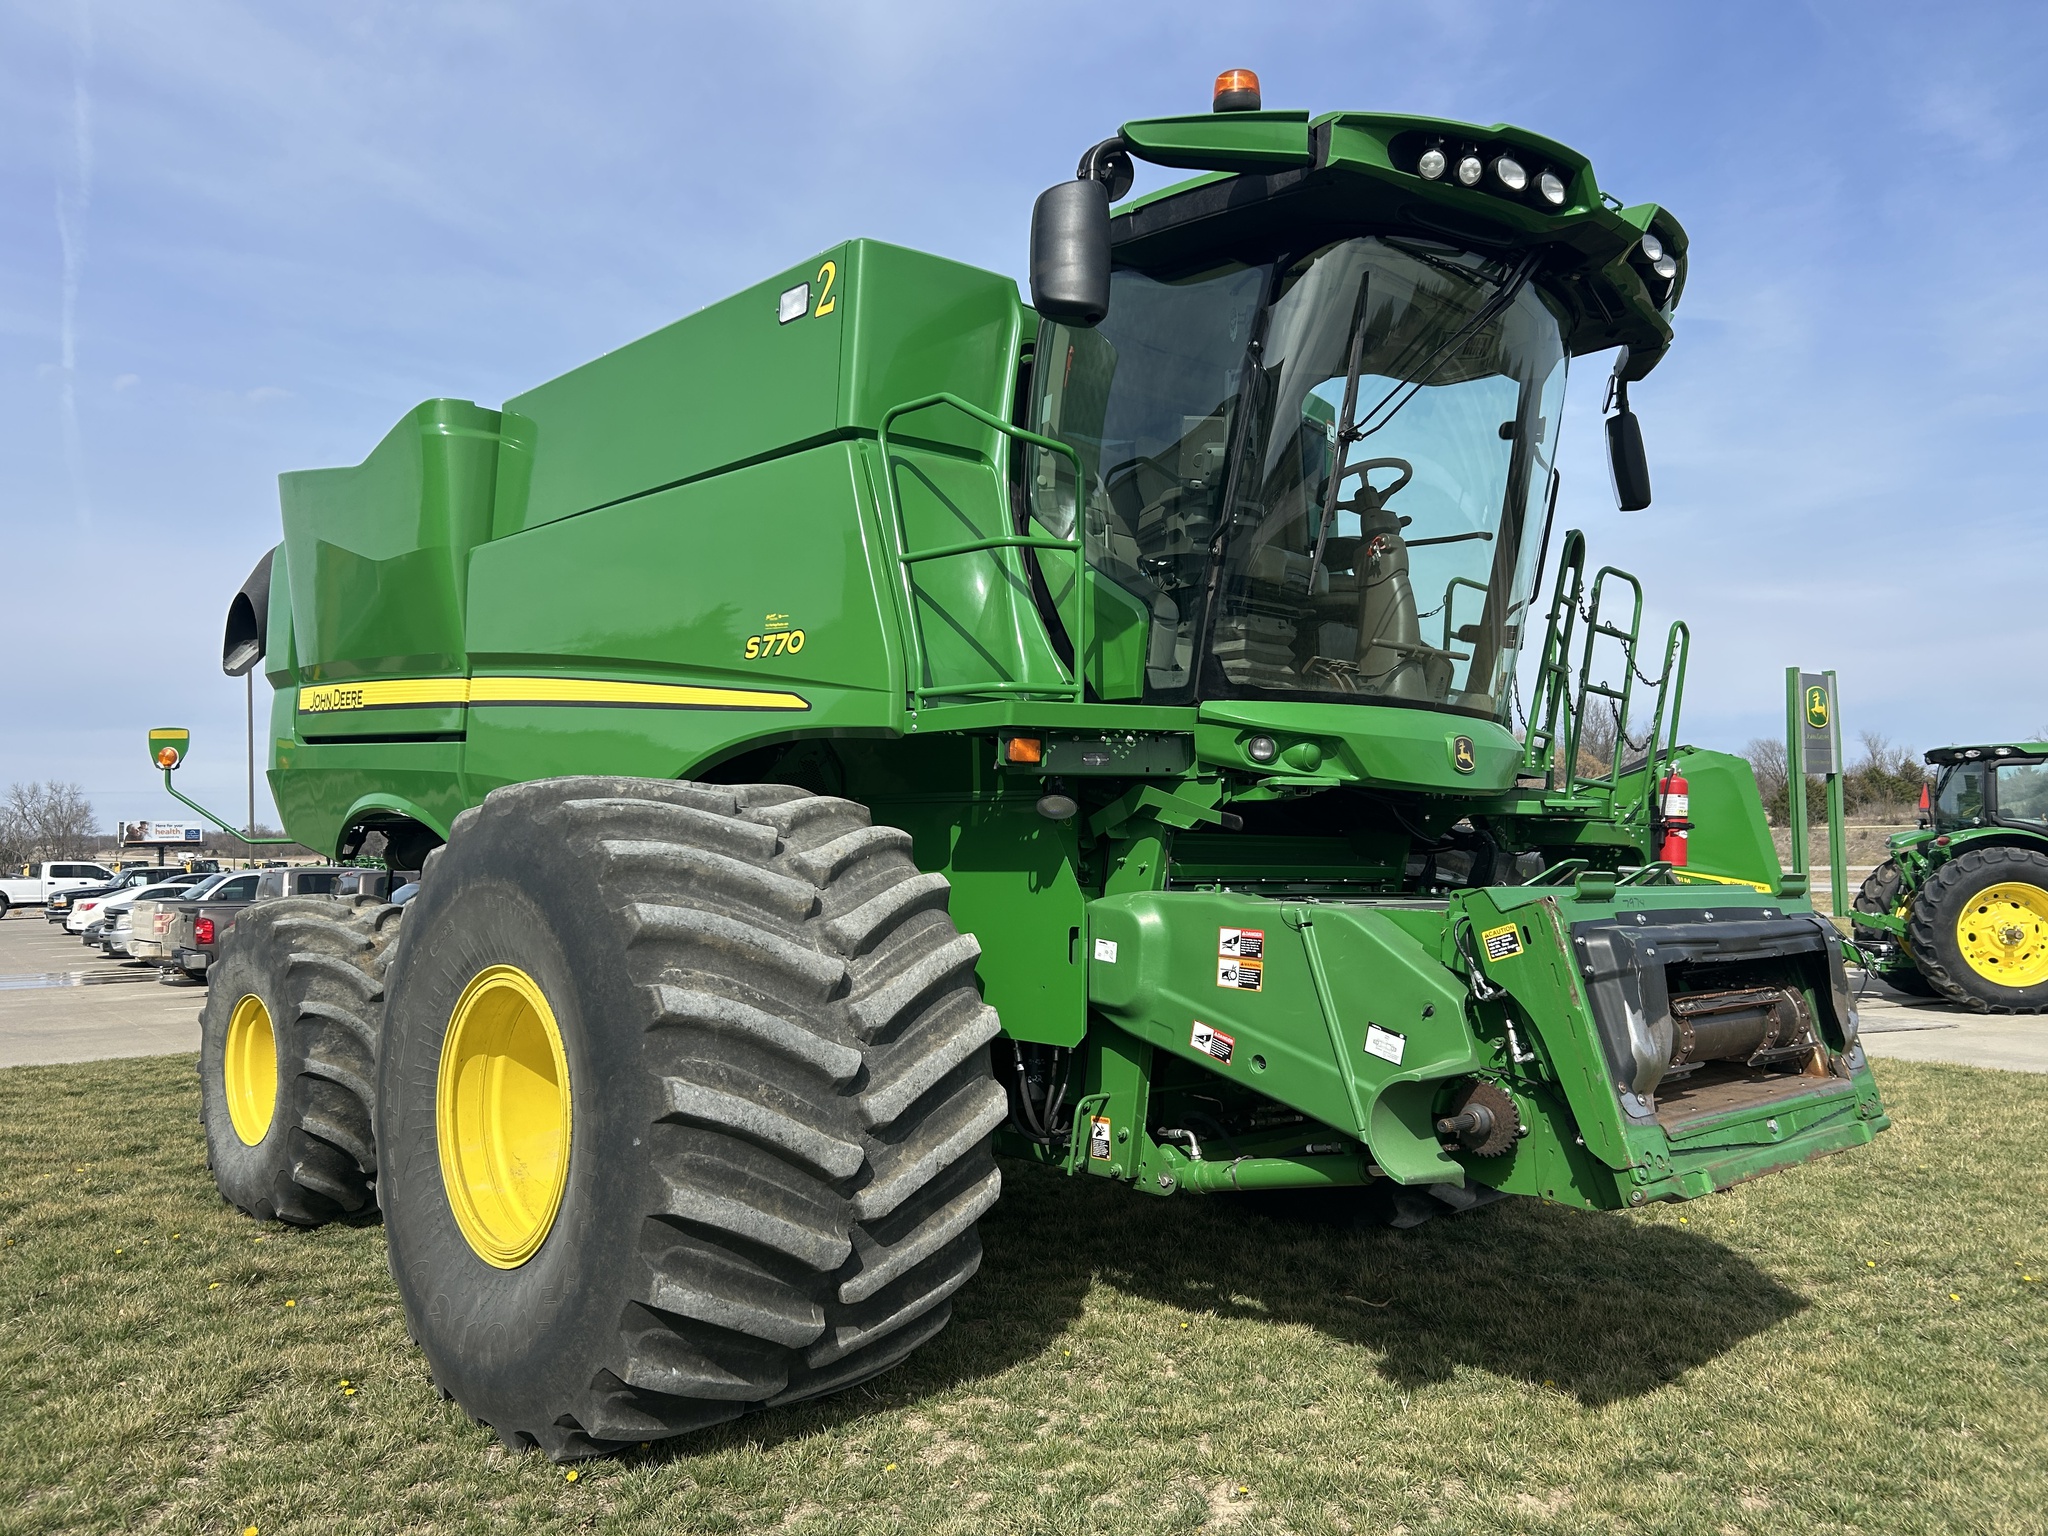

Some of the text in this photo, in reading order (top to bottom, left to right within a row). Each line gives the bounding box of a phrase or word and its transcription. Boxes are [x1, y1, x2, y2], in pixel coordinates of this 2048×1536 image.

[814, 259, 837, 319] 2
[744, 628, 805, 660] S770
[309, 688, 363, 709] JOHN DEERE
[1488, 924, 1516, 938] CAUTION
